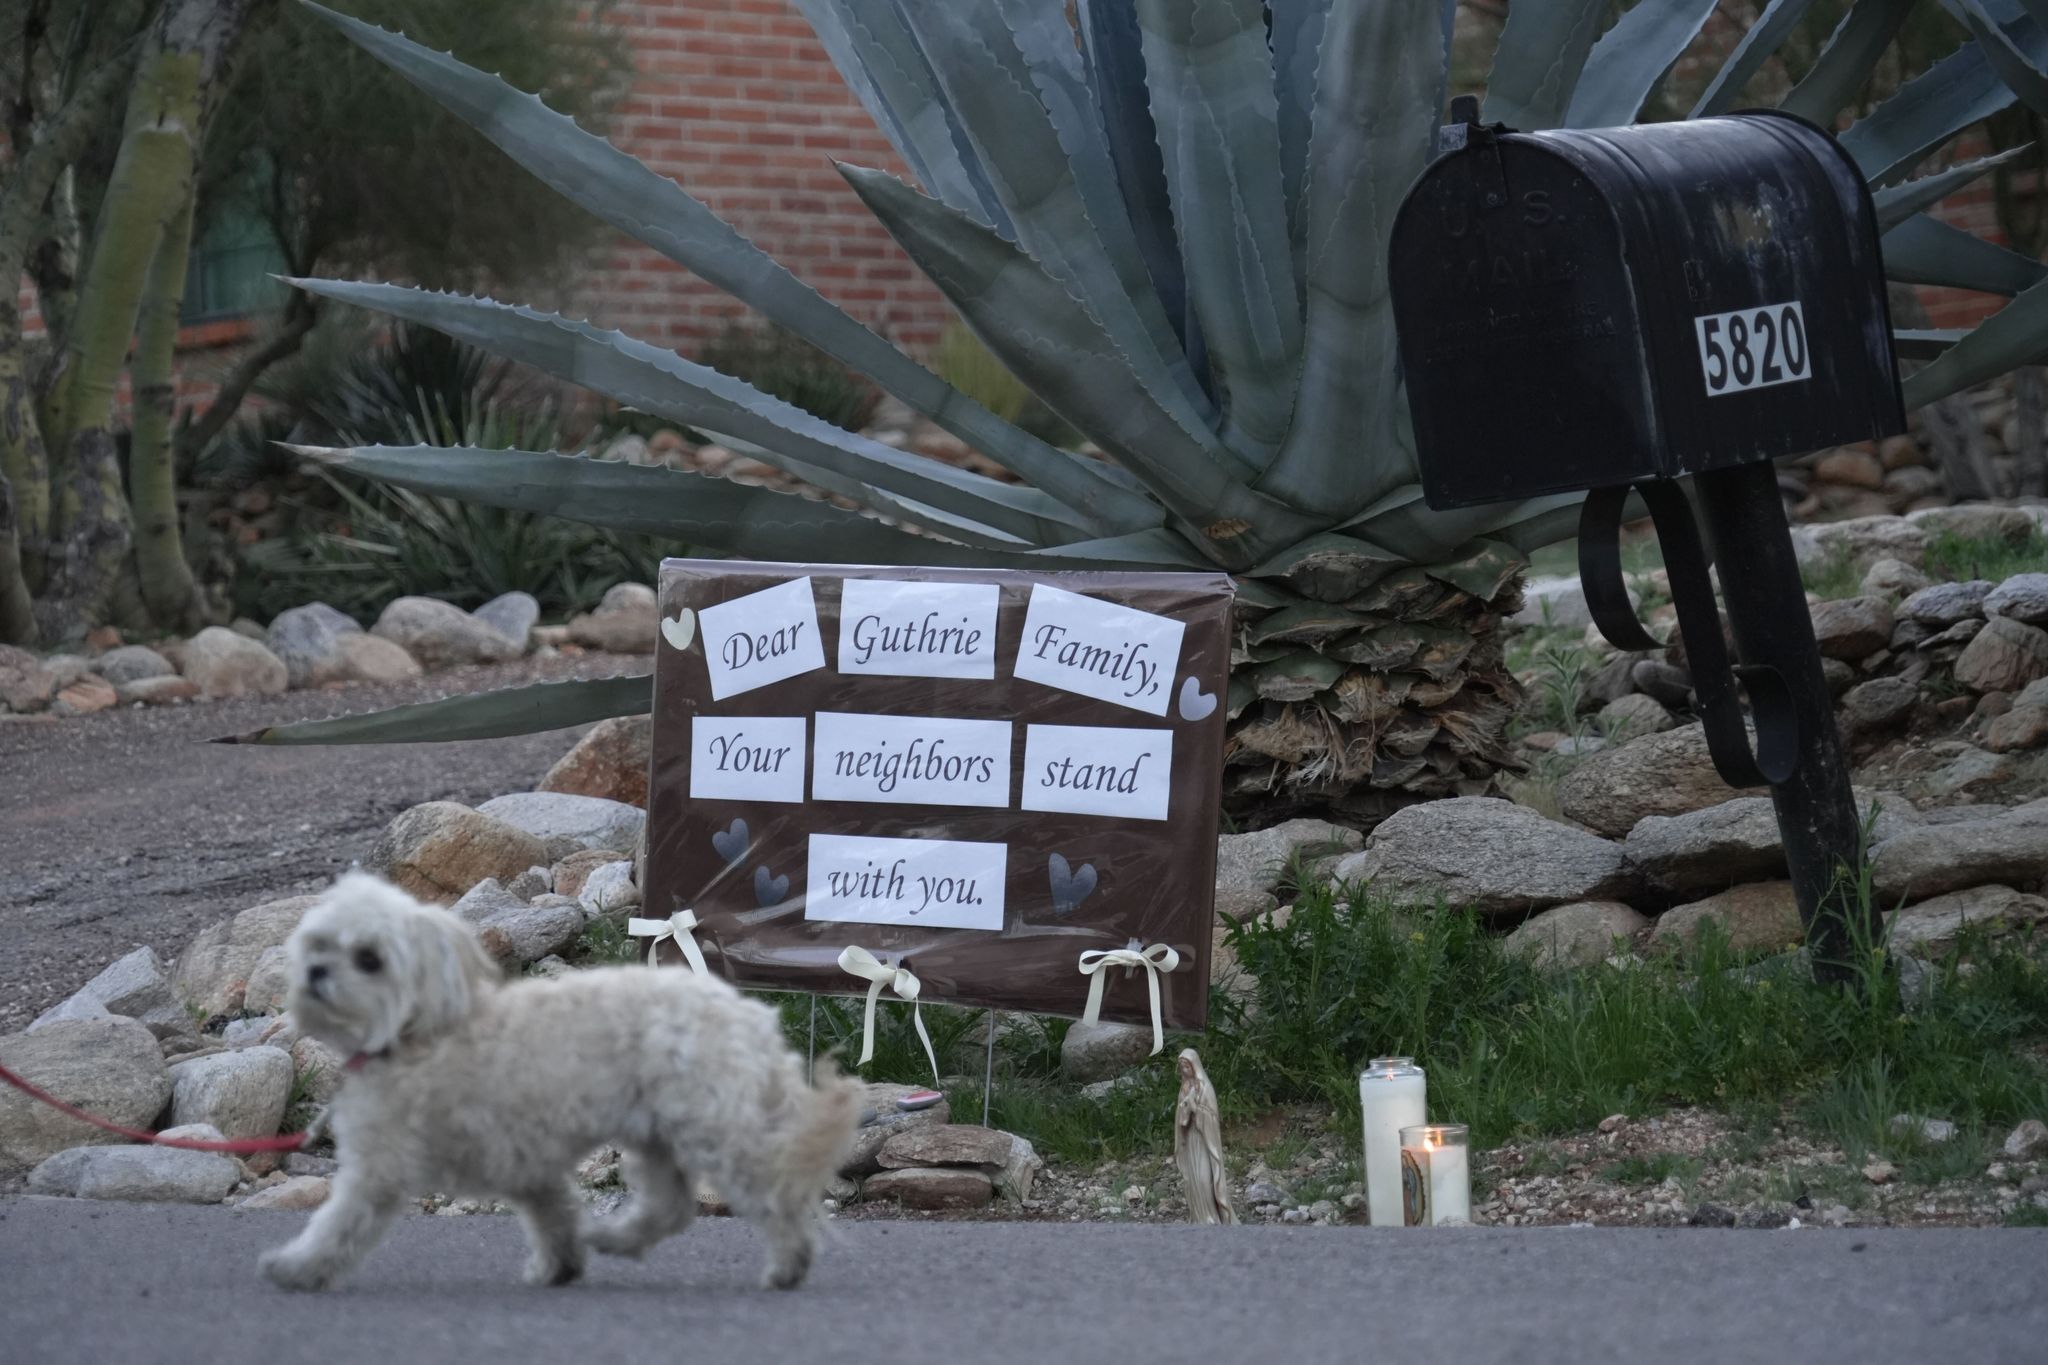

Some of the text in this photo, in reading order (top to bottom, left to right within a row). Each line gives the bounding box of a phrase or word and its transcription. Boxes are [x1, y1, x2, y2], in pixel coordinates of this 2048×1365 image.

[1704, 306, 1803, 390] 5820
[723, 612, 1158, 697] Dear Guthrie Family,
[710, 733, 1151, 793] Your neighbors stand
[828, 859, 983, 916] with you.
